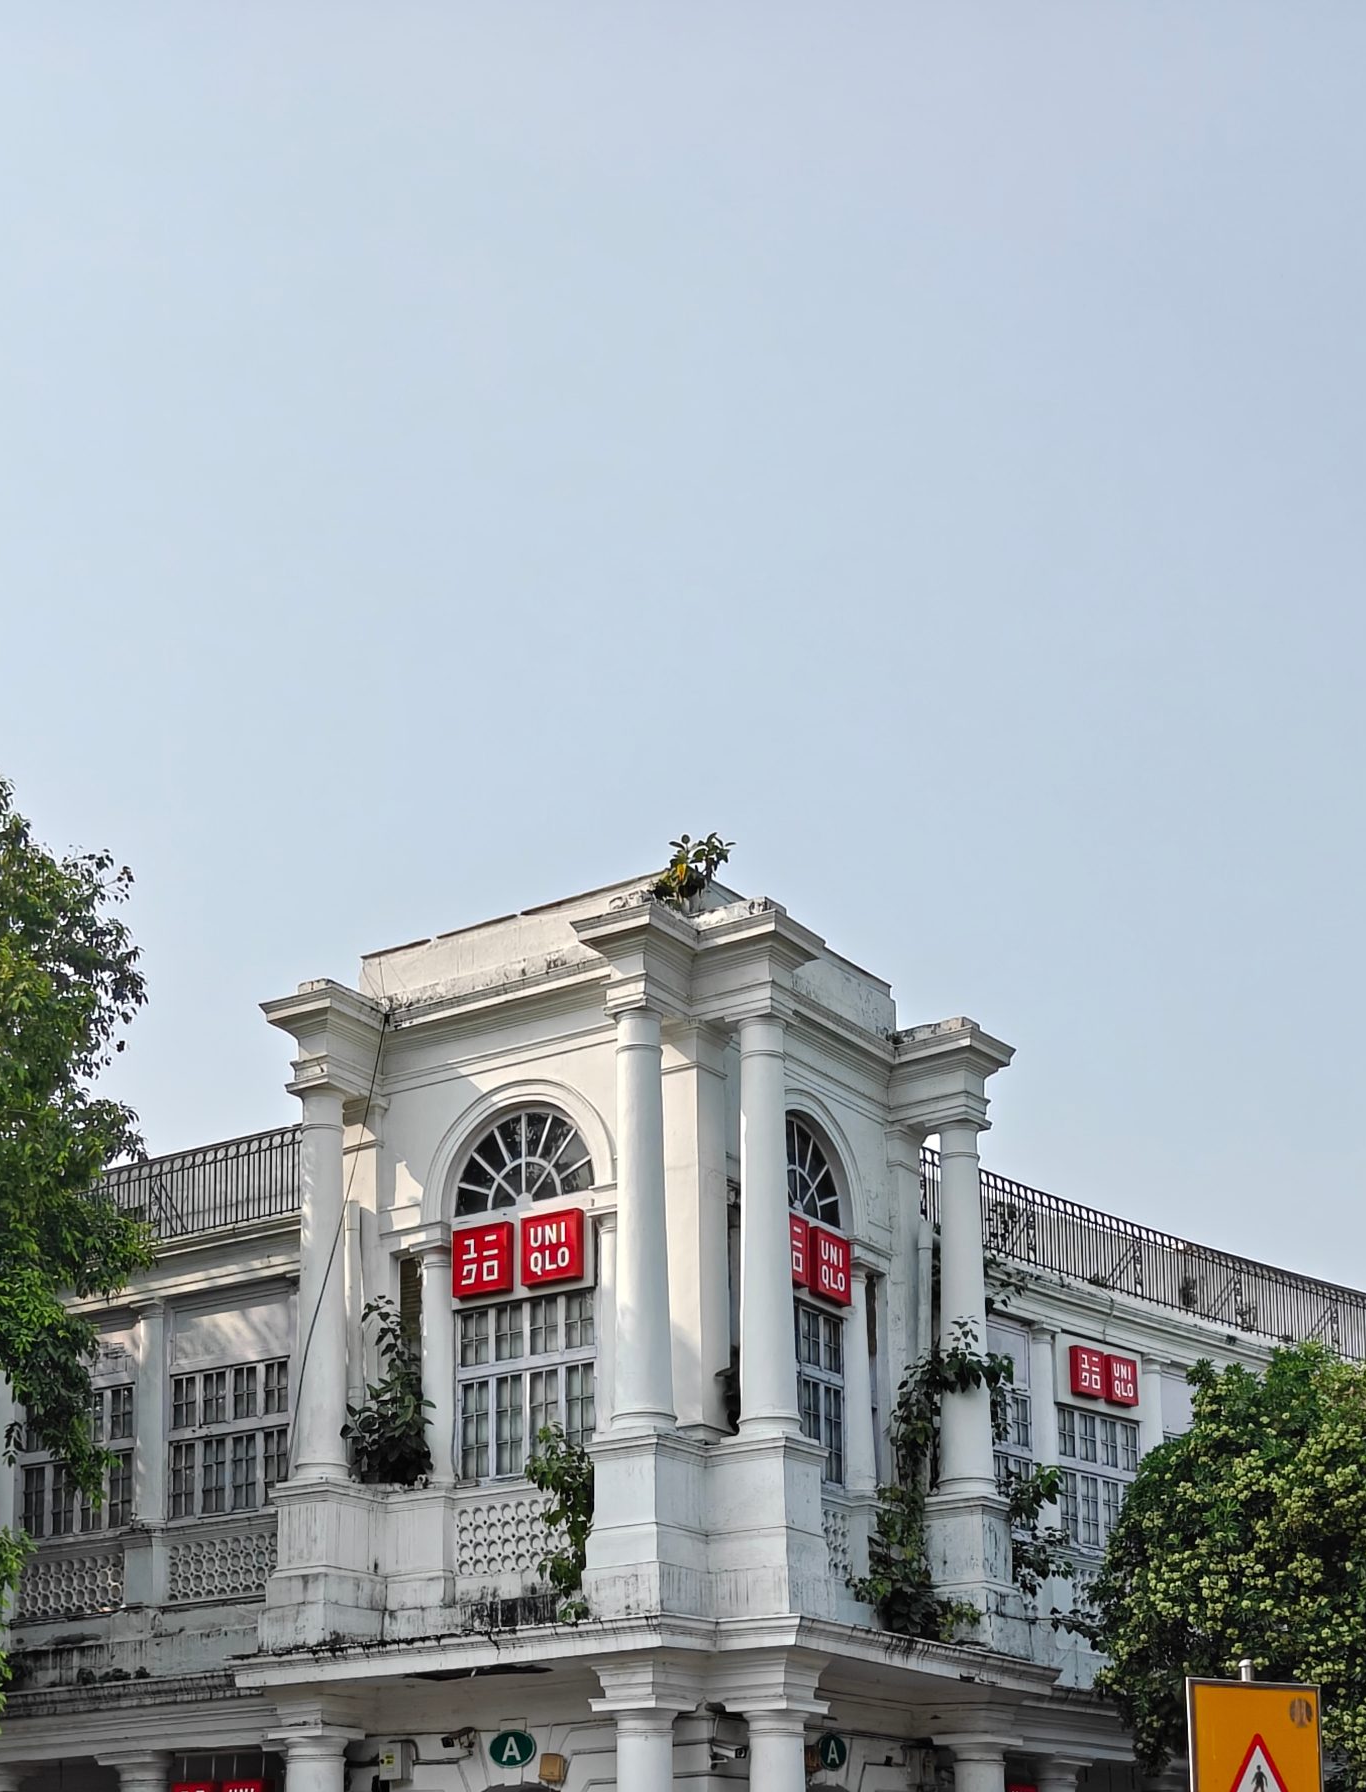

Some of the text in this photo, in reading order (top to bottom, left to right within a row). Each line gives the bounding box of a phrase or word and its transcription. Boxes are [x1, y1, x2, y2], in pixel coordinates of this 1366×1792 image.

[530, 1222, 566, 1247] UNI
[530, 1246, 570, 1275] QLO
[821, 1240, 842, 1268] UNI
[821, 1265, 845, 1292] QLO
[1113, 1362, 1131, 1380] UNI
[1114, 1380, 1134, 1398] QLO
[501, 1736, 521, 1762] A
[826, 1740, 839, 1764] A
